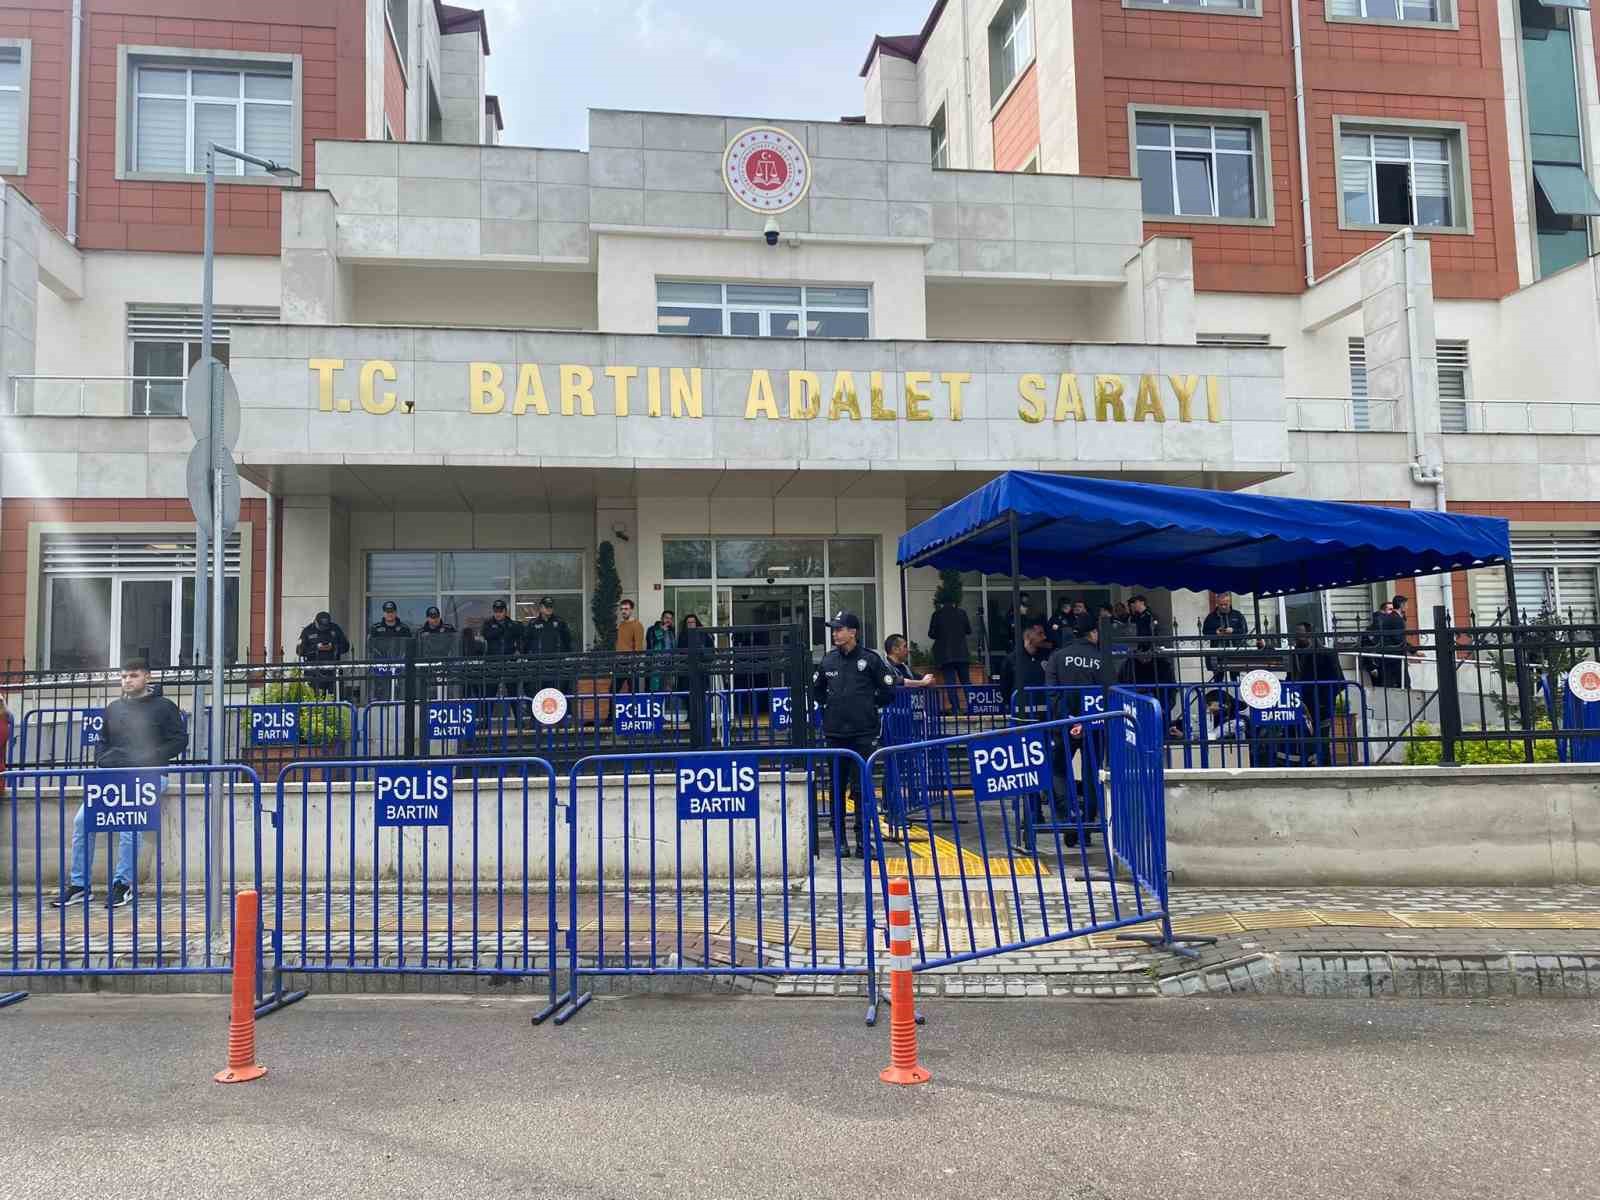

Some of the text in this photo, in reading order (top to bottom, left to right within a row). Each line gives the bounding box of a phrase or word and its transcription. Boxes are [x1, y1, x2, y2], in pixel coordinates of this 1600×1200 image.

[308, 358, 1220, 424] T.C. BARTIN ADALET SARAYI
[253, 708, 295, 728] POLİS
[615, 699, 661, 719] POLİS
[1261, 711, 1296, 721] BARTIN
[257, 729, 289, 740] BARTN
[974, 736, 1045, 775] POLİS
[378, 769, 448, 800] POLİS
[680, 760, 755, 794] POLİS
[987, 770, 1039, 793] BARTIN
[87, 777, 157, 808] POLİS
[386, 804, 438, 820] BARTIN
[690, 796, 746, 814] BARTIN
[96, 810, 148, 826] BARTIN
